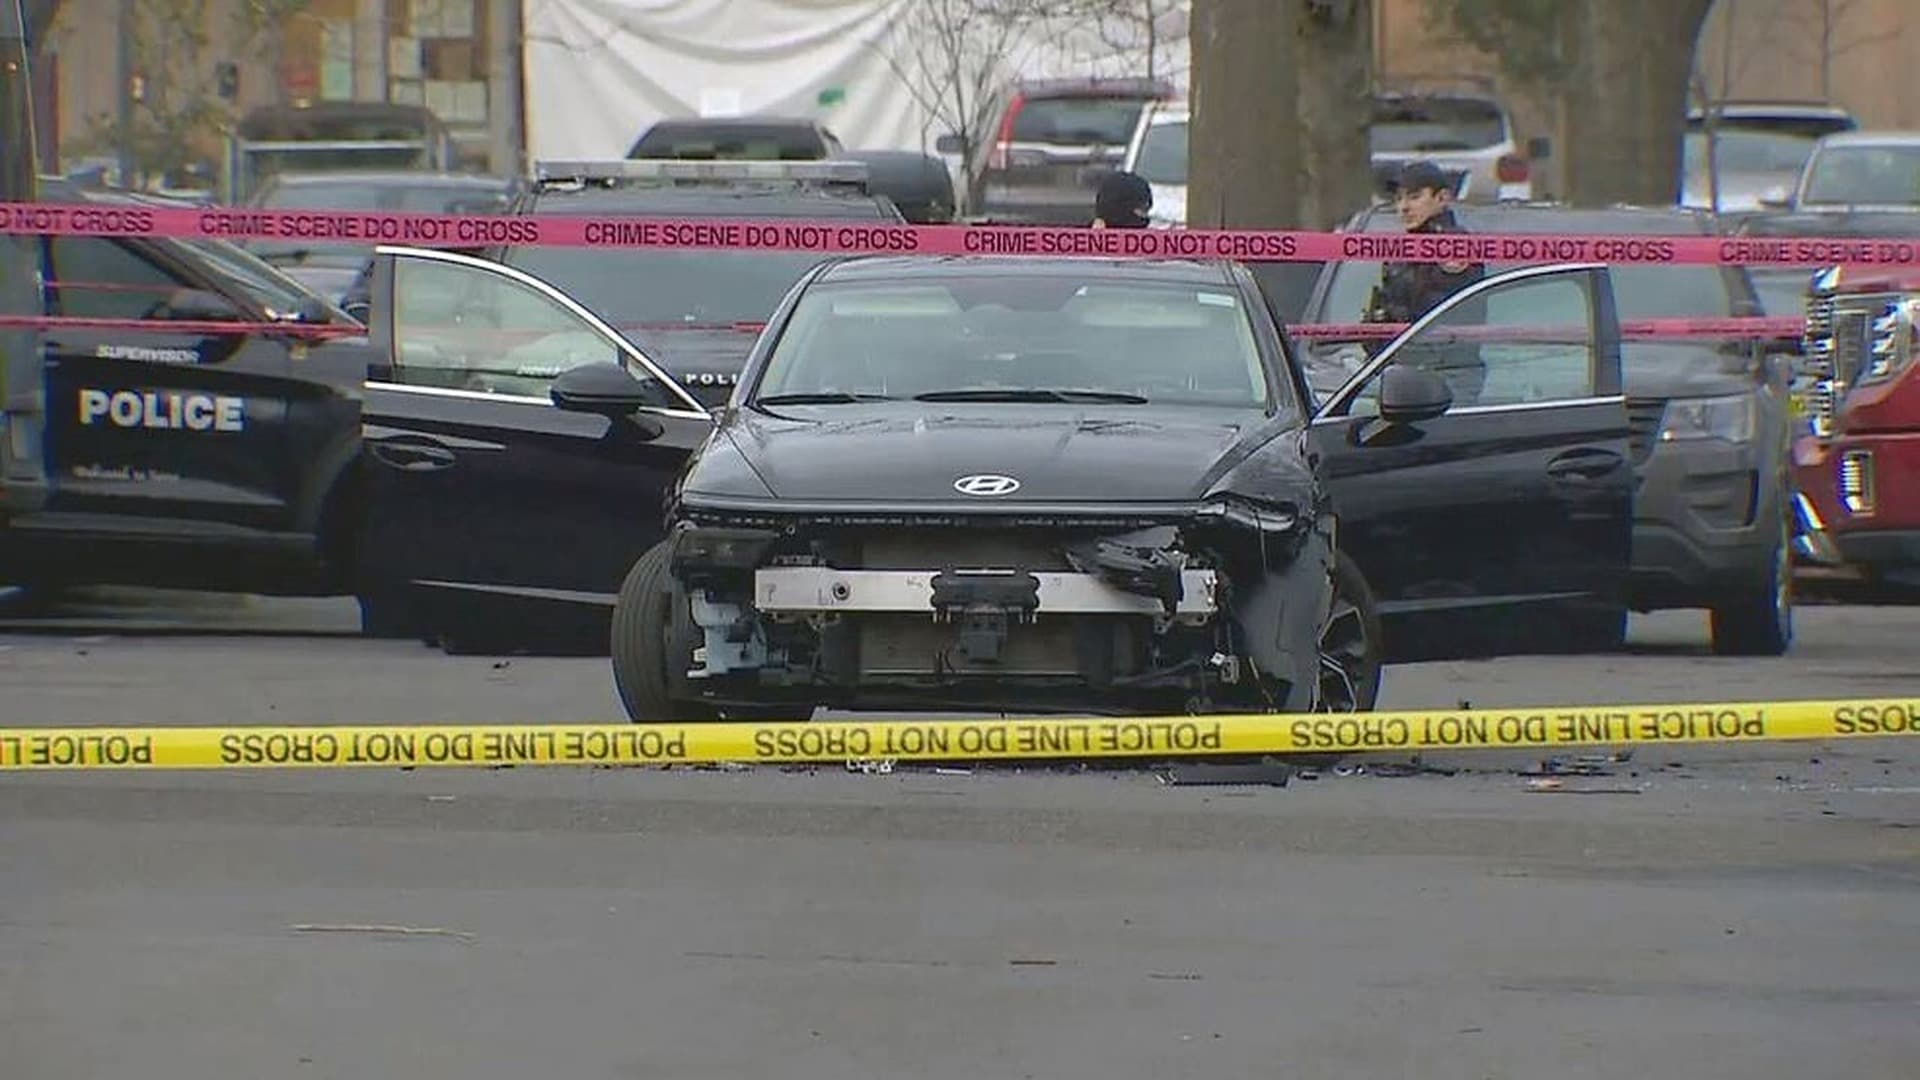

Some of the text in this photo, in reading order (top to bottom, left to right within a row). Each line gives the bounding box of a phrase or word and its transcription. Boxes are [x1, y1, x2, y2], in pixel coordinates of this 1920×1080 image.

[15, 209, 66, 230] NOT
[71, 210, 153, 232] CROSS
[200, 214, 539, 242] CRIME SCENE DO NOT CROSS
[585, 223, 919, 250] CRIME SCENE DO NOT CROSS
[964, 231, 1297, 256] CRIME SCENE DO NOT CROSS
[1343, 238, 1674, 261] CRIME SCENE DO NOT CROSS
[1720, 241, 1914, 264] CRIME SCENE DO
[79, 389, 244, 431] POLICE
[754, 723, 1221, 757] POLICE LINE DO NOT CROSS
[1291, 711, 1764, 747] POLICE LINE DO NOT CROSS
[31, 736, 152, 765] POLICE
[220, 731, 685, 763] POLICE LINE DO NOT CROSS
